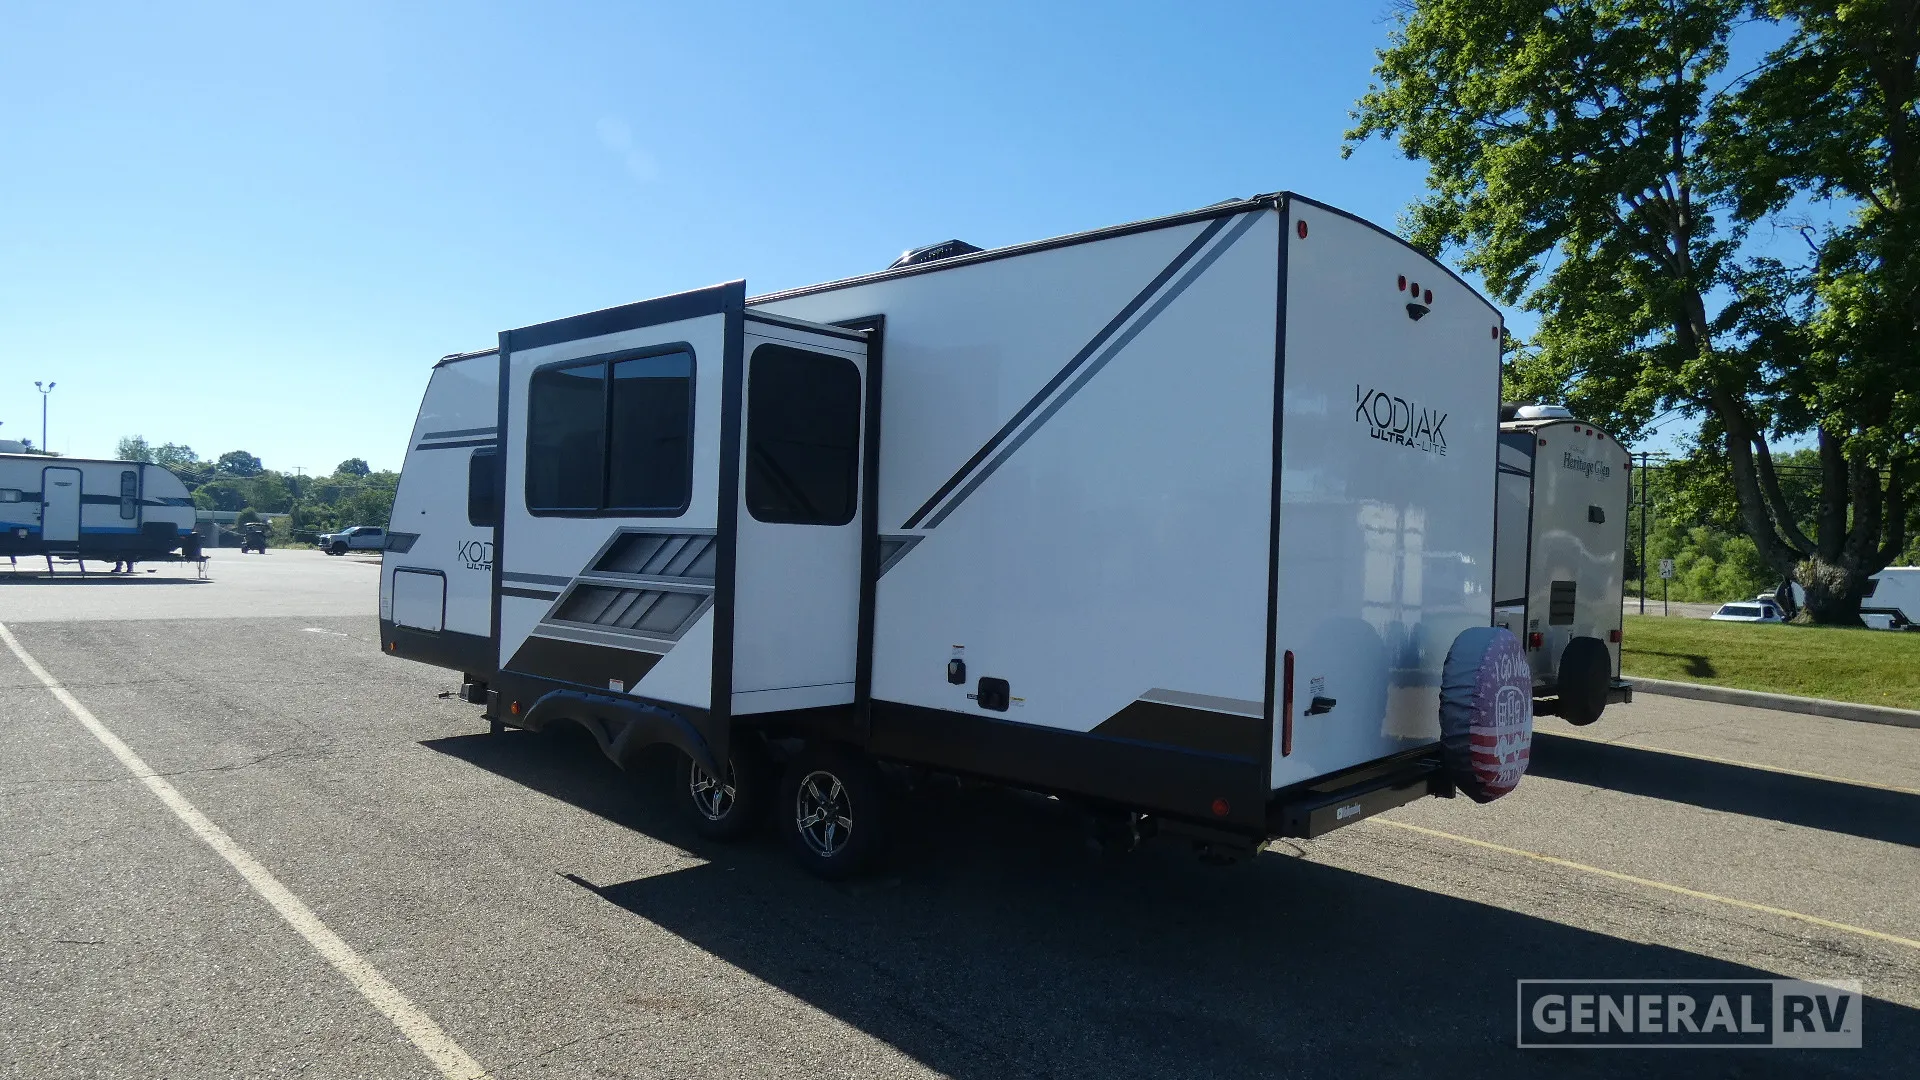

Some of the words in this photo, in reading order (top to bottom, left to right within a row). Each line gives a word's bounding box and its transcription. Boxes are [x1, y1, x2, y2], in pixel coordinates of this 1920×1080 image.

[1355, 384, 1448, 447] KODIAK
[1370, 427, 1447, 457] ULTRA-LITE
[1563, 451, 1594, 479] Heritage
[1594, 460, 1610, 478] Glen
[458, 540, 494, 564] KOD
[466, 563, 492, 571] ULTR
